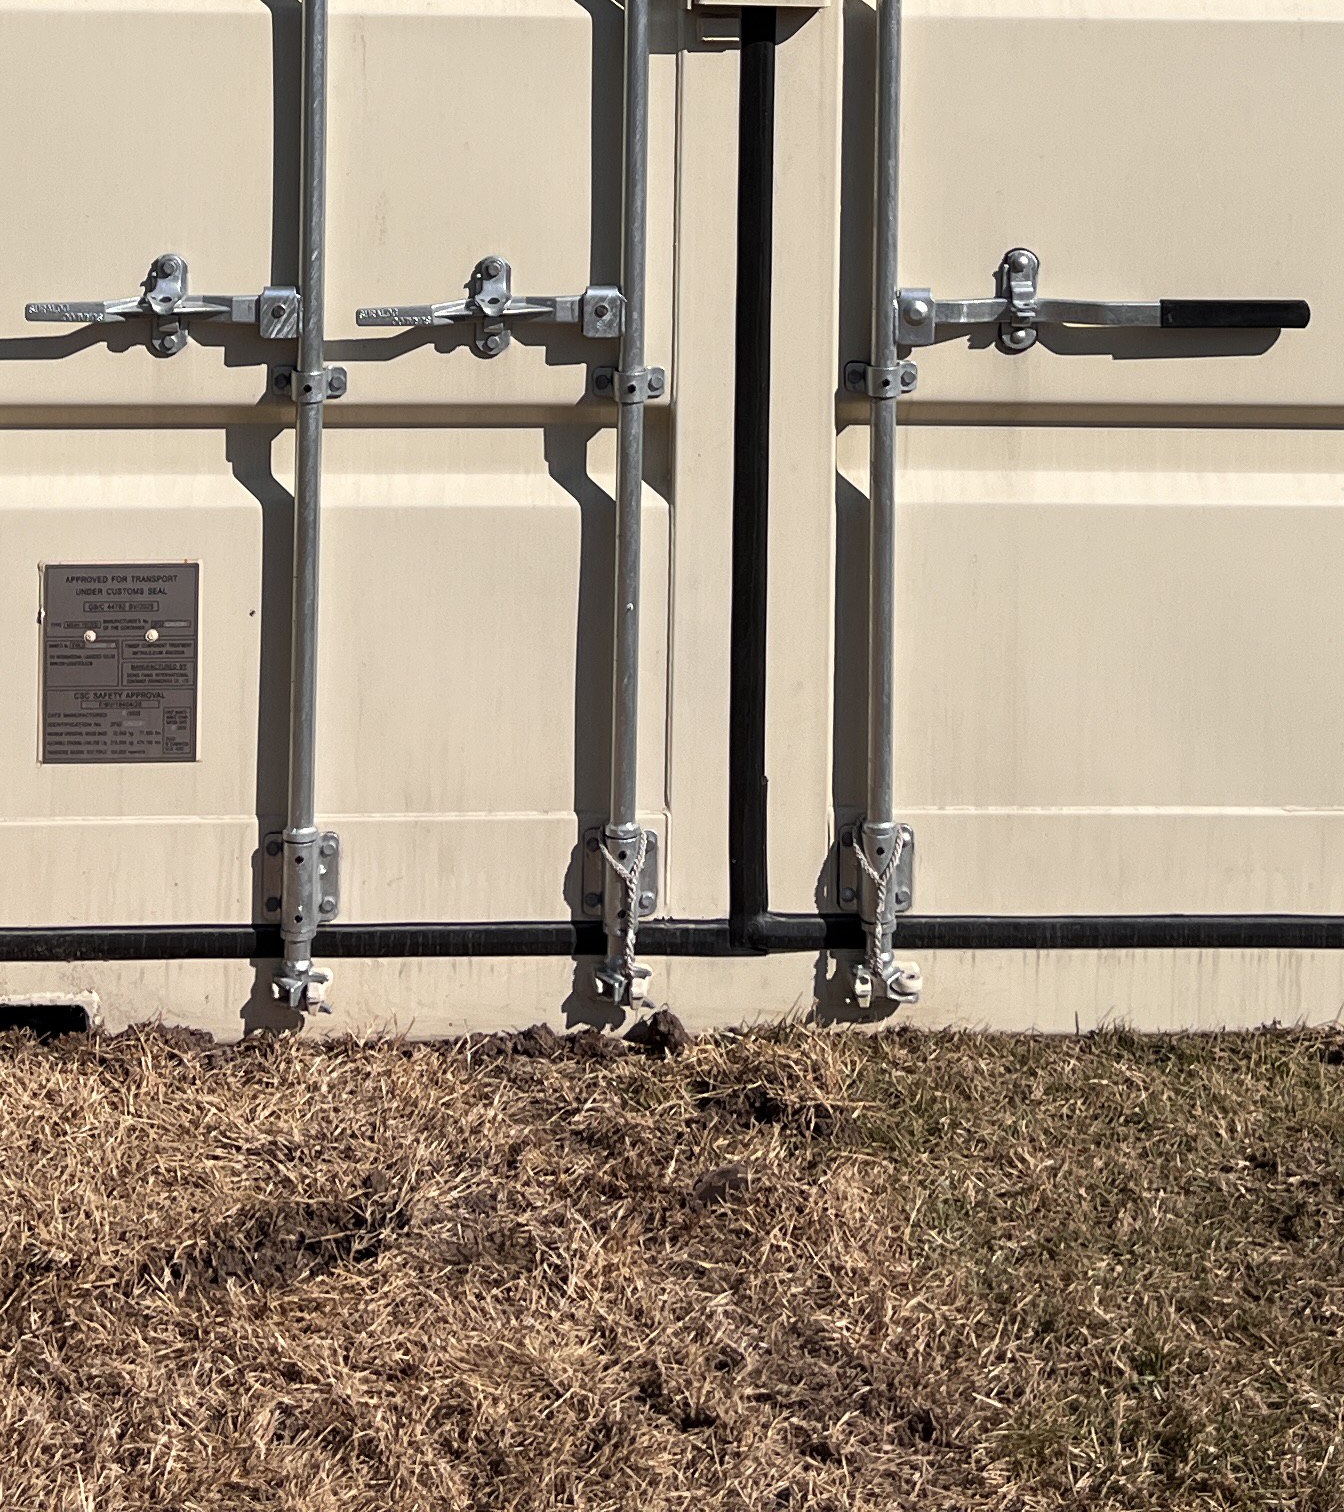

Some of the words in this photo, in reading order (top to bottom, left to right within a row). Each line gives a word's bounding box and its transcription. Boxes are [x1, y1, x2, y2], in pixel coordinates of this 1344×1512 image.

[131, 575, 177, 583] TRANSPORT
[76, 588, 103, 596] UNDER
[106, 588, 144, 596] CUSTOMS
[125, 691, 165, 699] APPROVAL
